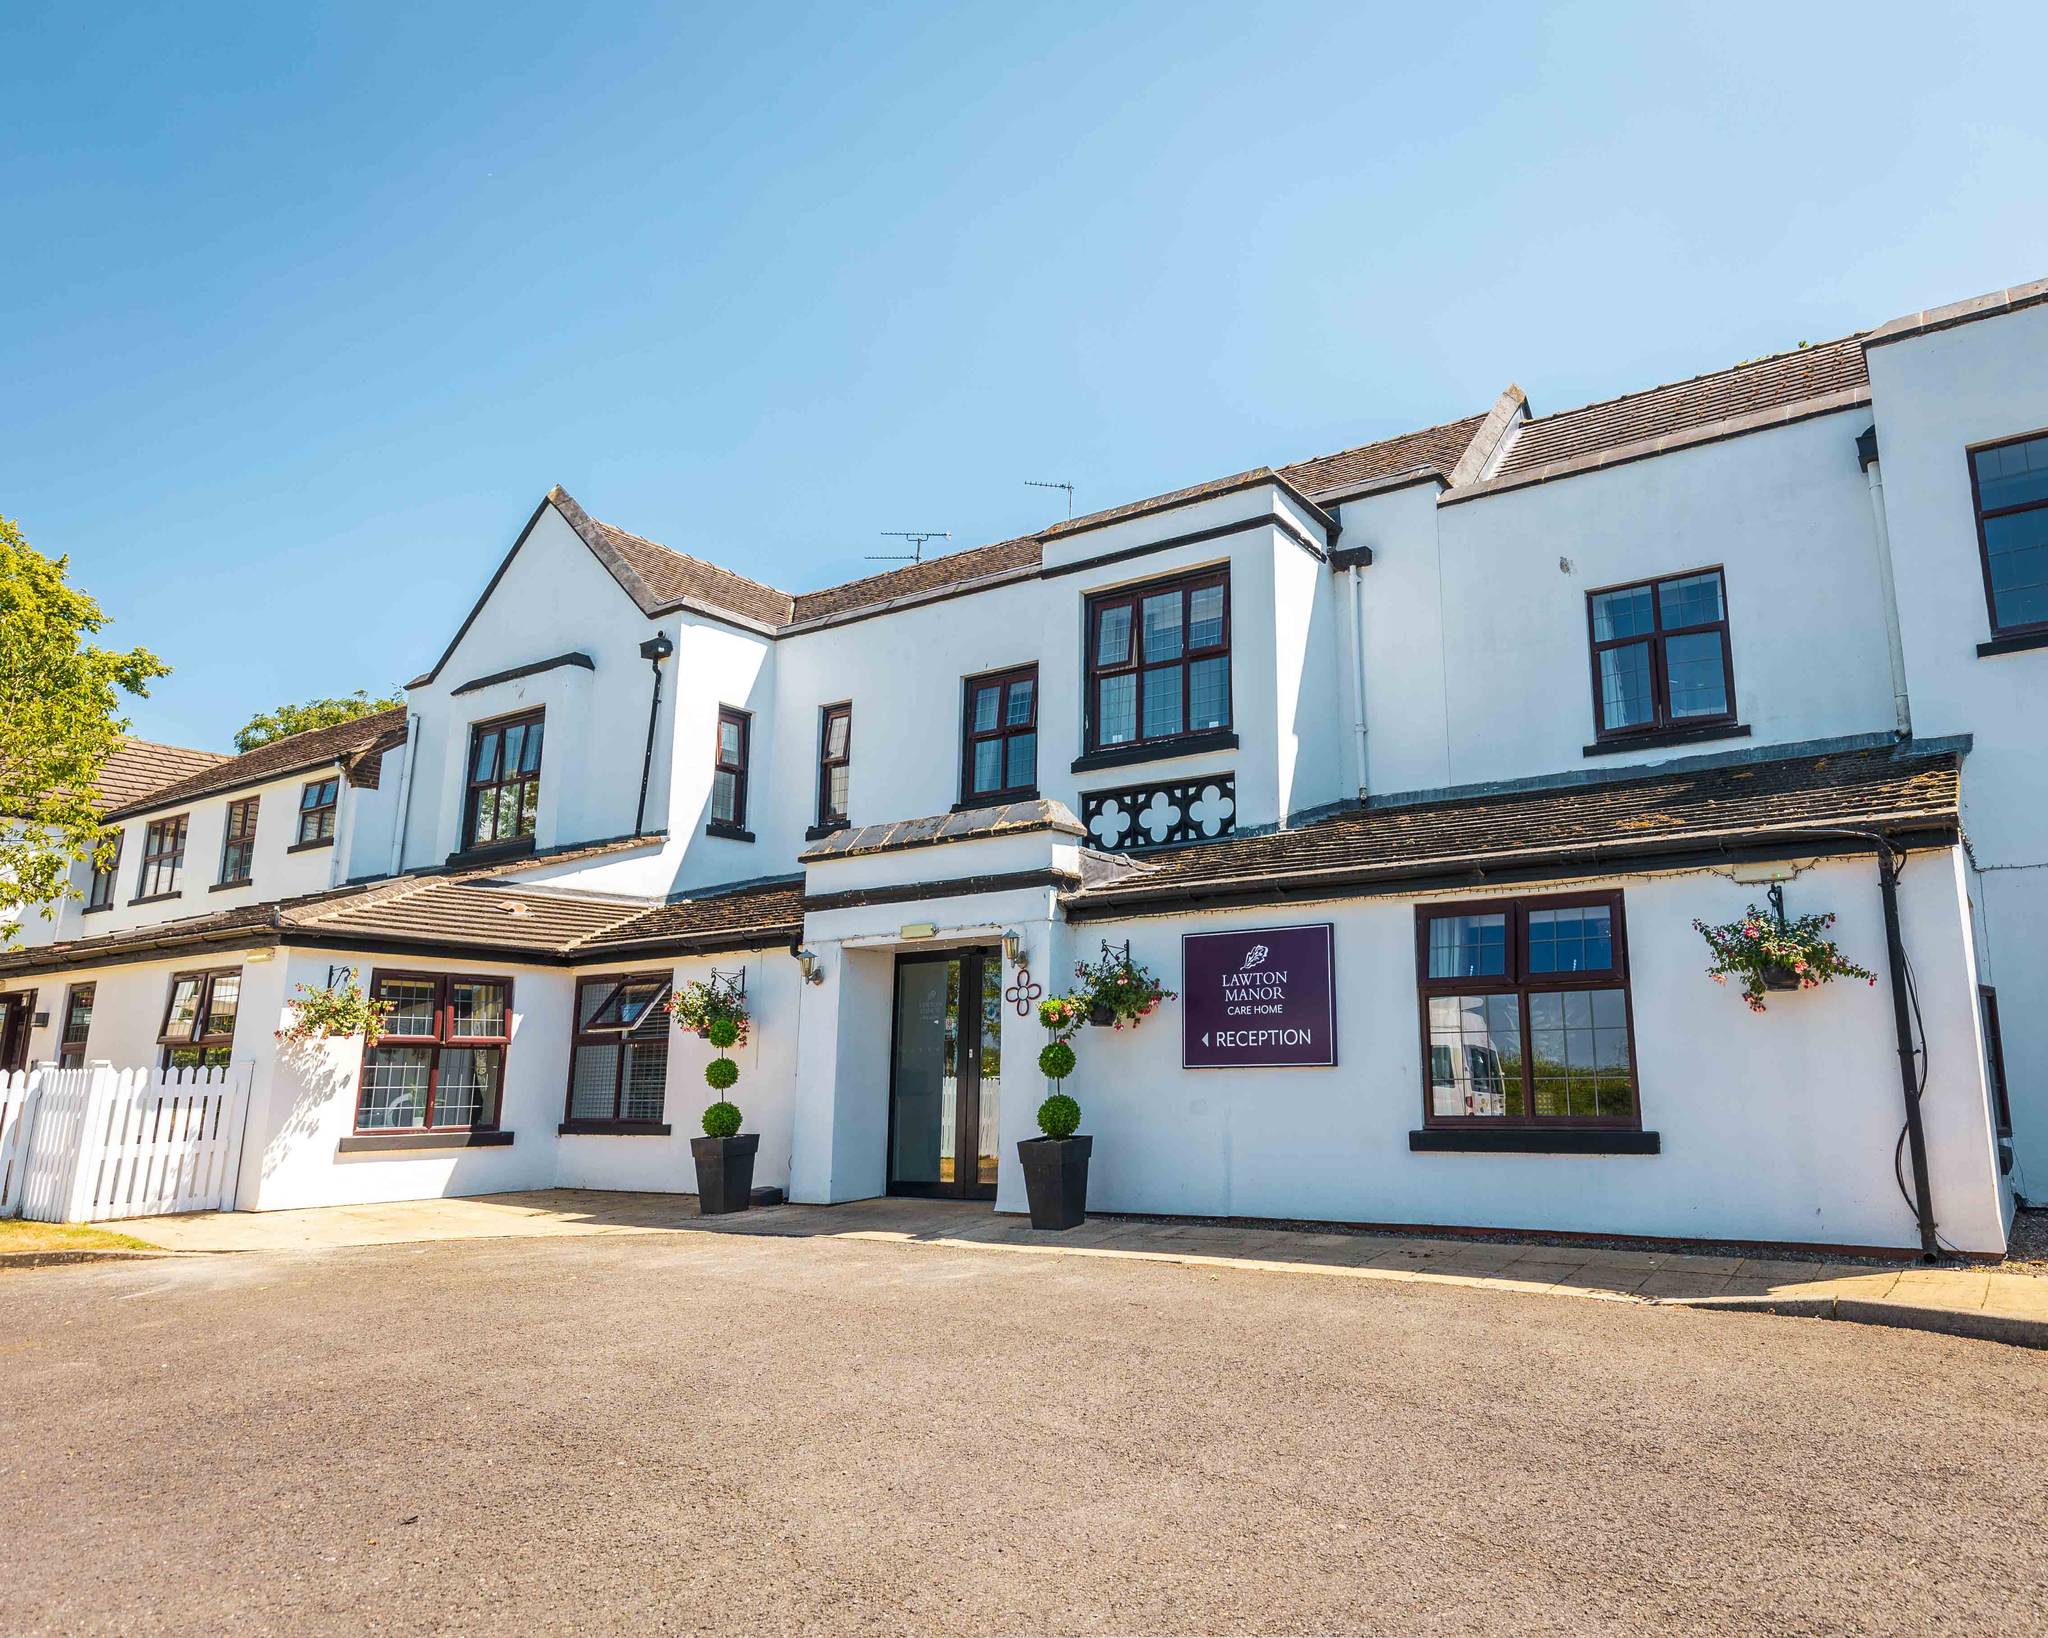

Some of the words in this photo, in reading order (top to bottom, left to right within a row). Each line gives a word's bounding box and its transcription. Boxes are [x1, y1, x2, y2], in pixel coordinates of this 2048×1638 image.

[1222, 971, 1287, 987] LAWTON
[1225, 987, 1286, 1002] MANOR
[1227, 1005, 1252, 1016] CARE
[1254, 1004, 1283, 1015] HOME
[1216, 1029, 1311, 1047] RECEPTION
